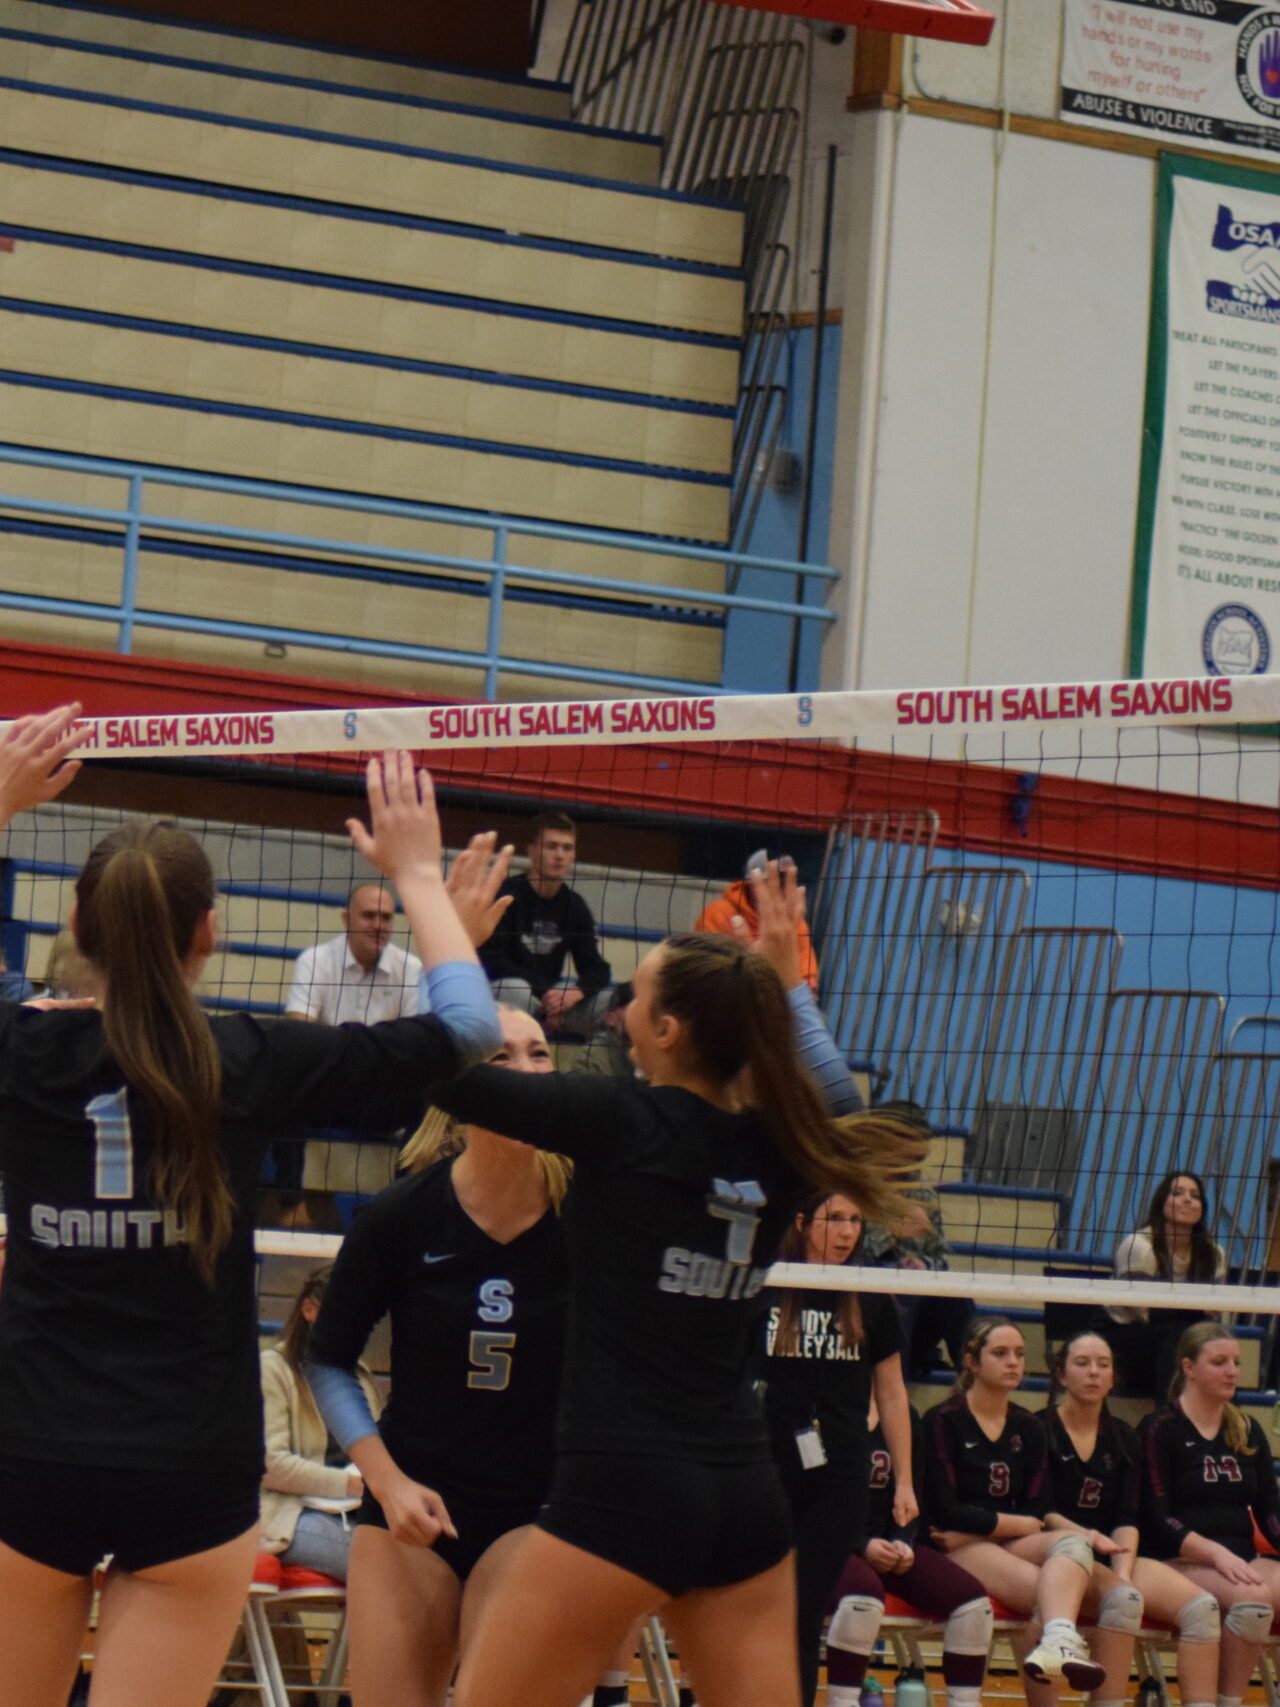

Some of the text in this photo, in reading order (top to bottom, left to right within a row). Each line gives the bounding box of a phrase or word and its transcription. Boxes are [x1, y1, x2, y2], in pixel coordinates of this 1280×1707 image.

[1073, 93, 1123, 116] ABUSE
[1139, 106, 1213, 135] VIOLENCE
[1216, 572, 1255, 590] ABOUT
[429, 699, 717, 739] SOUTH SALEM SAXONS
[797, 697, 813, 727] S
[897, 678, 1234, 725] SOUTH SALEM SAXONS
[105, 717, 180, 749] SALEM
[184, 714, 275, 748] SAXONS
[343, 712, 359, 740] S
[84, 1084, 134, 1200] 1
[477, 1279, 515, 1324] S
[466, 1330, 517, 1391] 5
[989, 1462, 1010, 1497] 9
[1203, 1455, 1243, 1483] 14
